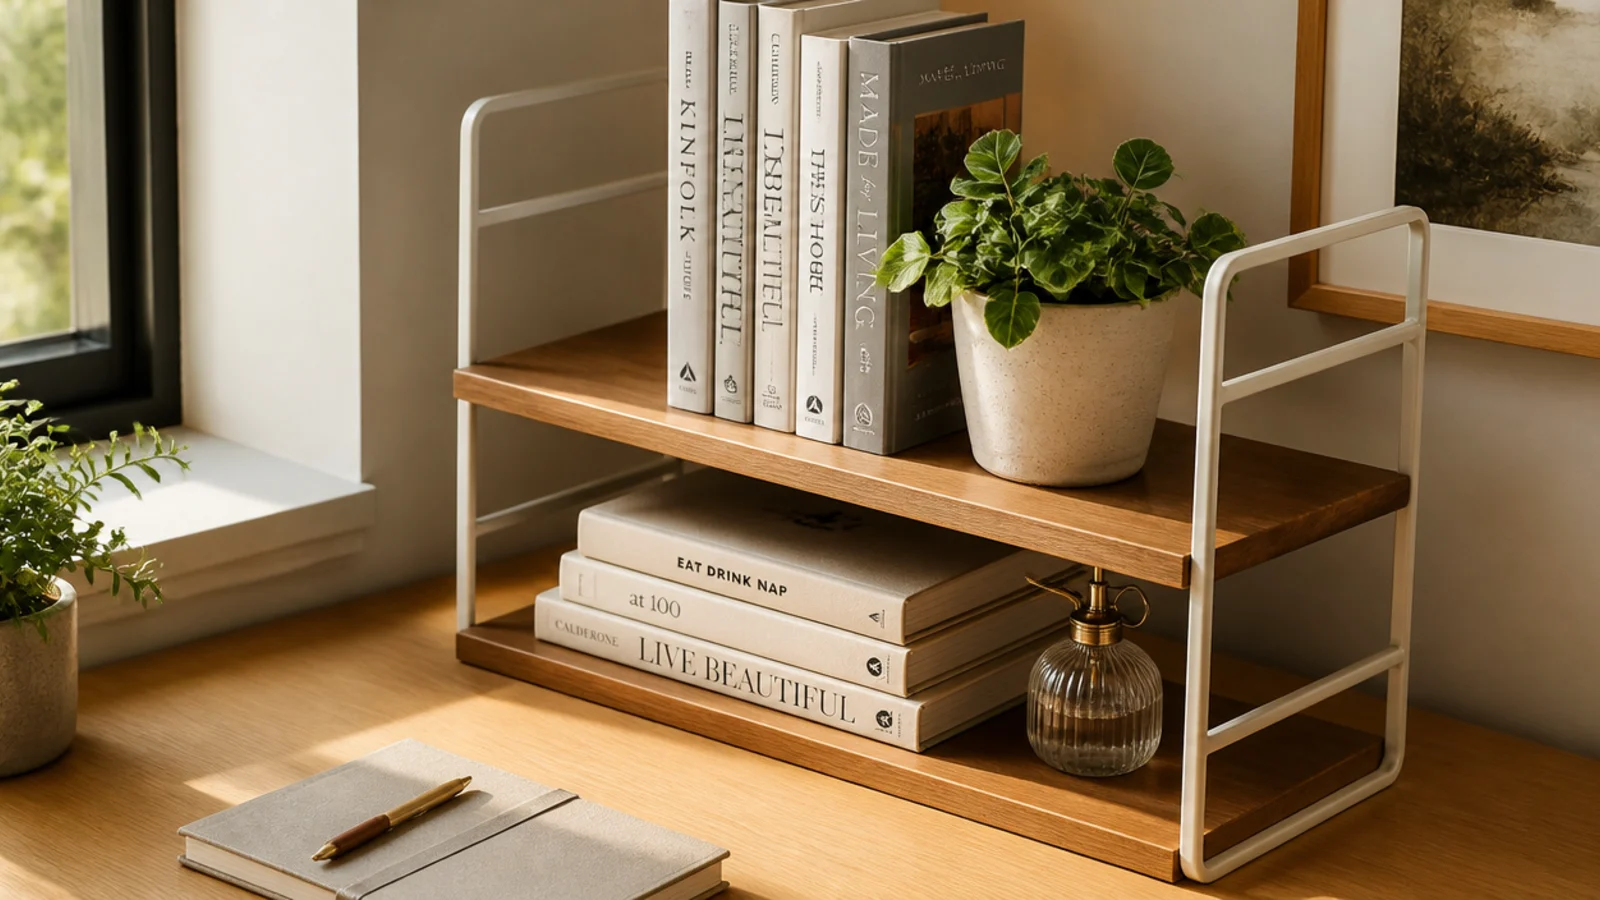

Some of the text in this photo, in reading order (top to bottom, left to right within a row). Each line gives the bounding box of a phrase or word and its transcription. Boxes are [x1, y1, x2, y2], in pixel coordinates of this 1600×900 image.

[680, 98, 696, 242] KINFOLK
[855, 209, 878, 335] LIVING
[629, 593, 681, 619] at 100
[677, 556, 787, 597] EAT DRINK NAP
[554, 619, 619, 648] CALDERONE
[639, 636, 696, 676] LIVE
[704, 655, 856, 724] BEAUTIFUL
